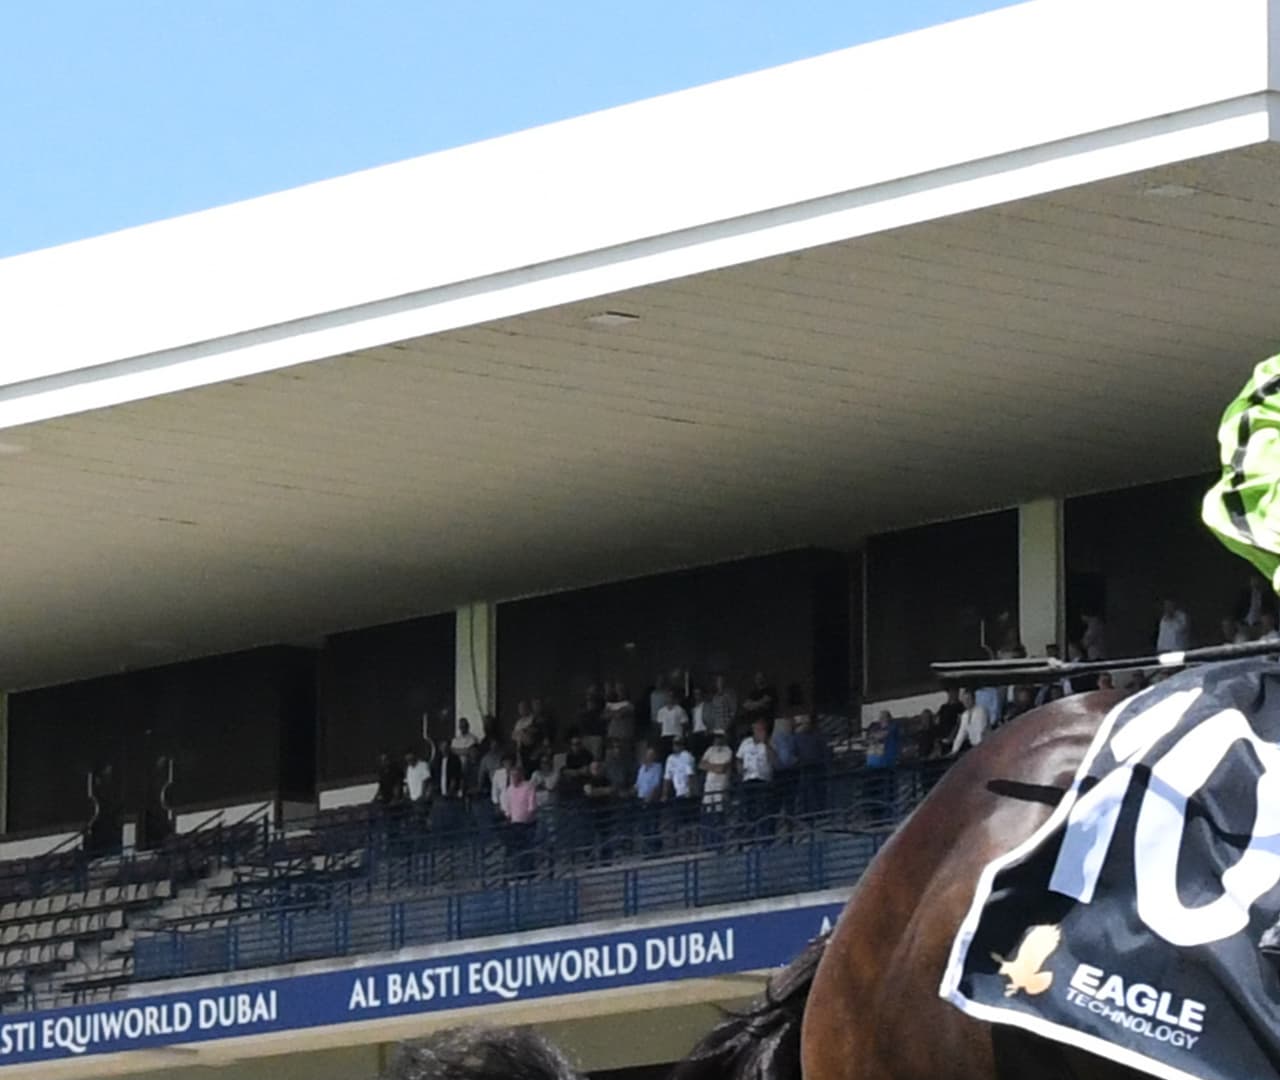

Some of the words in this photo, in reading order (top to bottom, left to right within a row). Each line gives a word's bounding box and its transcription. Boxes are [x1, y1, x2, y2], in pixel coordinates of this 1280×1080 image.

[349, 977, 381, 1010] AL
[387, 964, 460, 1005] BASTI
[468, 943, 638, 998] EQUIWORLD
[645, 930, 735, 971] DUBAI
[1069, 963, 1206, 1033] EAGLE
[43, 1003, 192, 1052] EQUIWORLD
[200, 990, 278, 1029] DUBAI
[1066, 987, 1199, 1050] TECHNOLOGY
